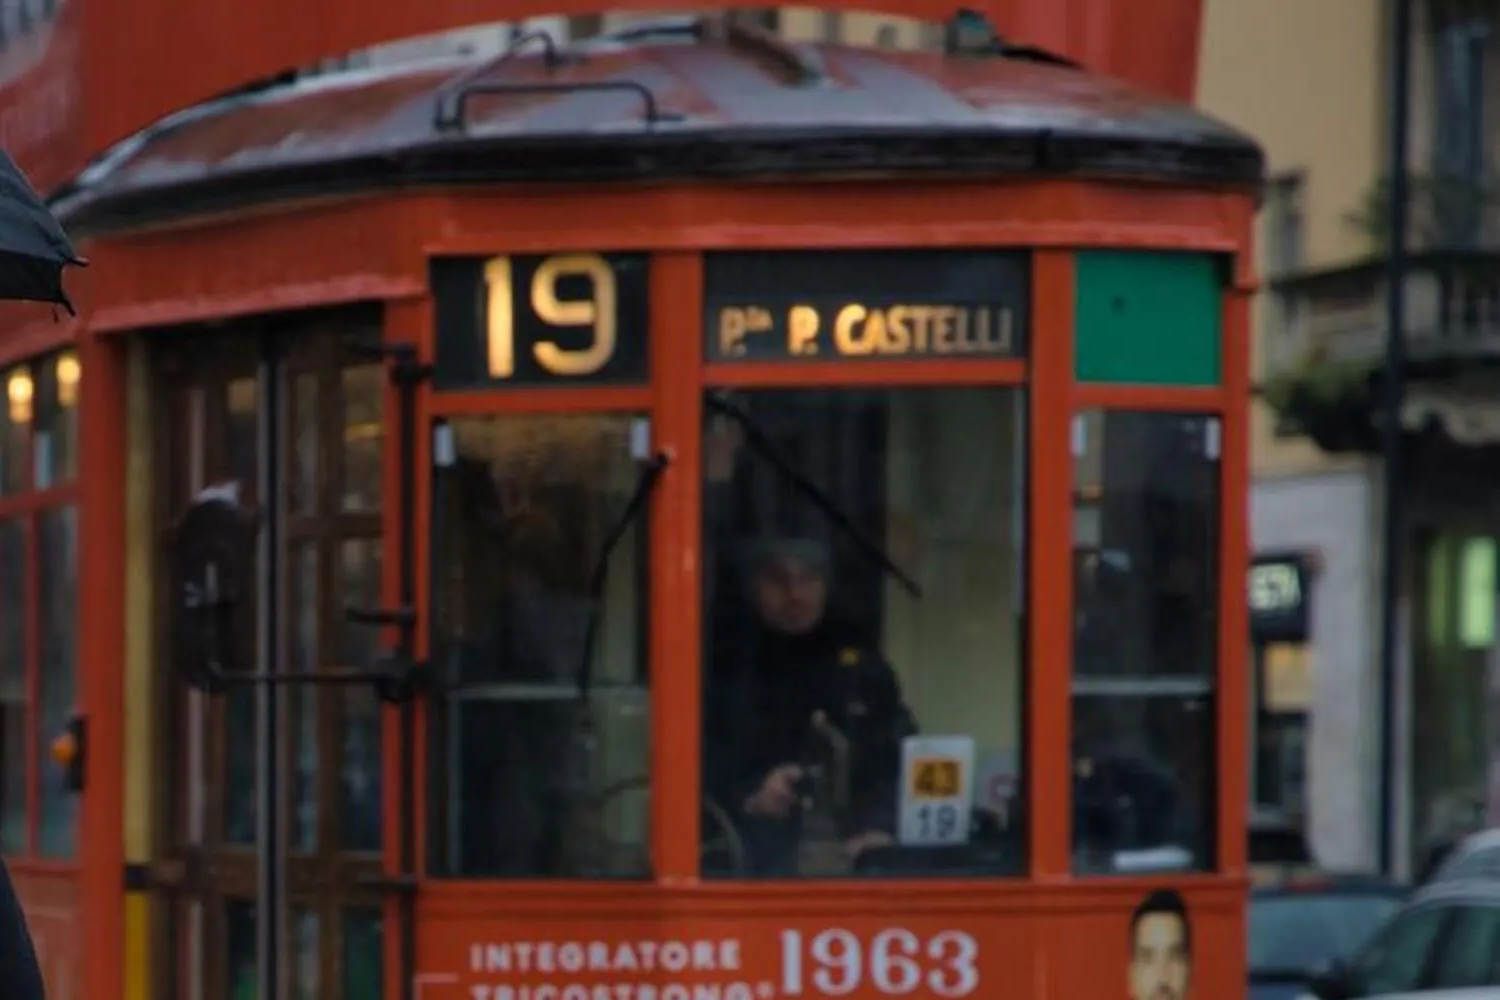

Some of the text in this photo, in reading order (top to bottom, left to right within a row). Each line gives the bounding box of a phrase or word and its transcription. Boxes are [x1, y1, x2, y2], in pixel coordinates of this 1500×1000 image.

[484, 254, 616, 379] 19
[788, 304, 820, 355] P.
[834, 303, 1013, 356] CASTELLI
[917, 804, 958, 841] 19
[470, 940, 741, 973] INTEGRATORE
[781, 927, 980, 998] 1963
